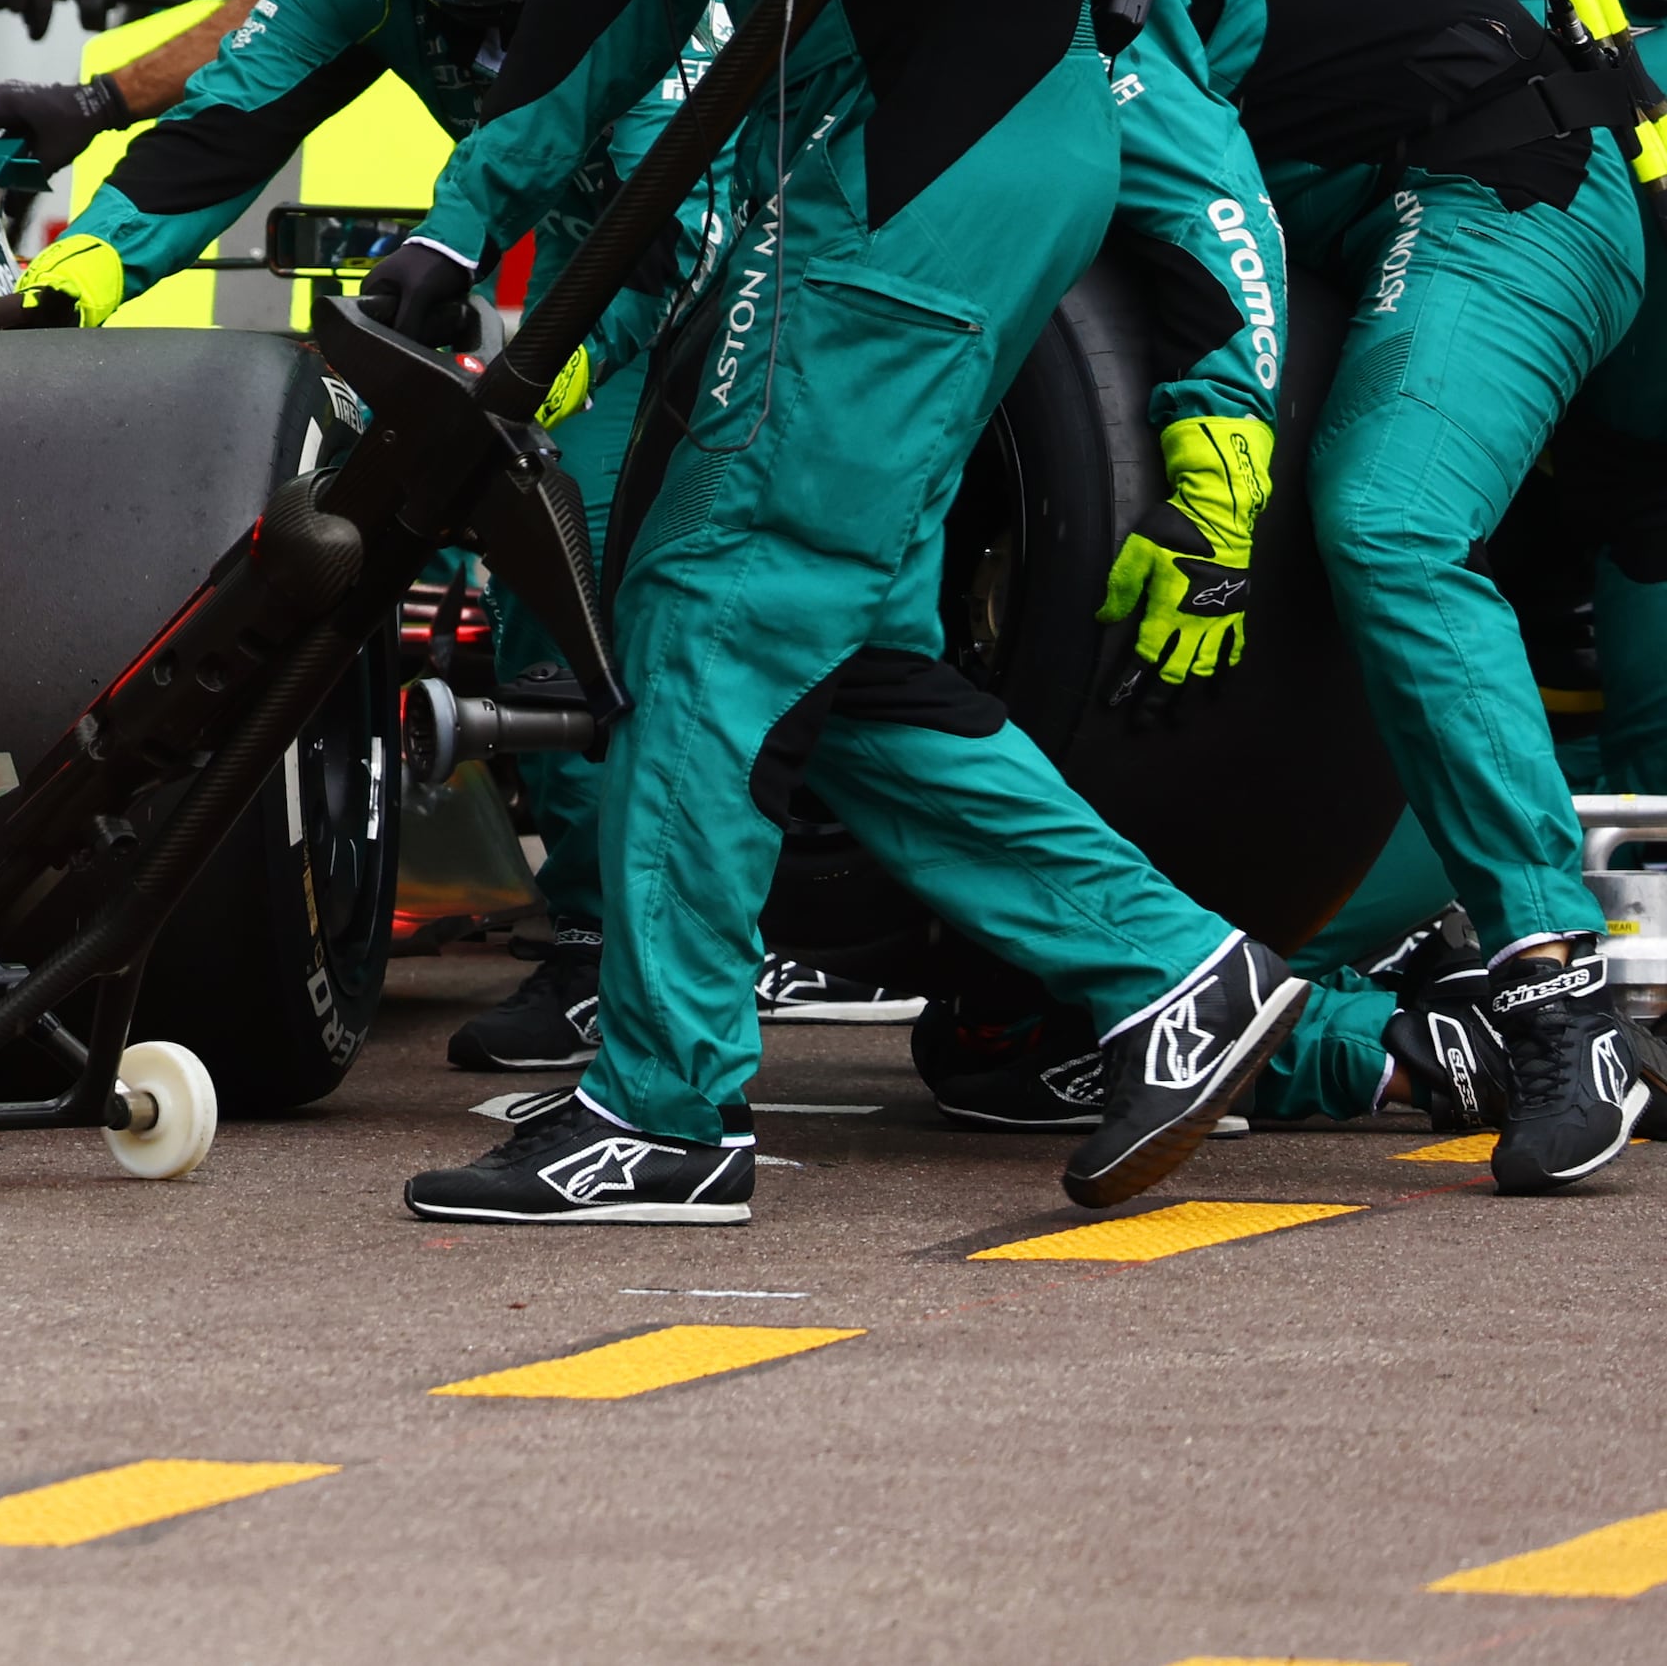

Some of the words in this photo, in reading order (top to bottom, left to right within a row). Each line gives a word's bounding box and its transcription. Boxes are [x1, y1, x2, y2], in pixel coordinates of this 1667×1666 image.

[1207, 197, 1279, 391] aramco
[1373, 230, 1415, 313] ASTON
[710, 268, 768, 408] ASTON
[1492, 967, 1591, 1013] alpinestars
